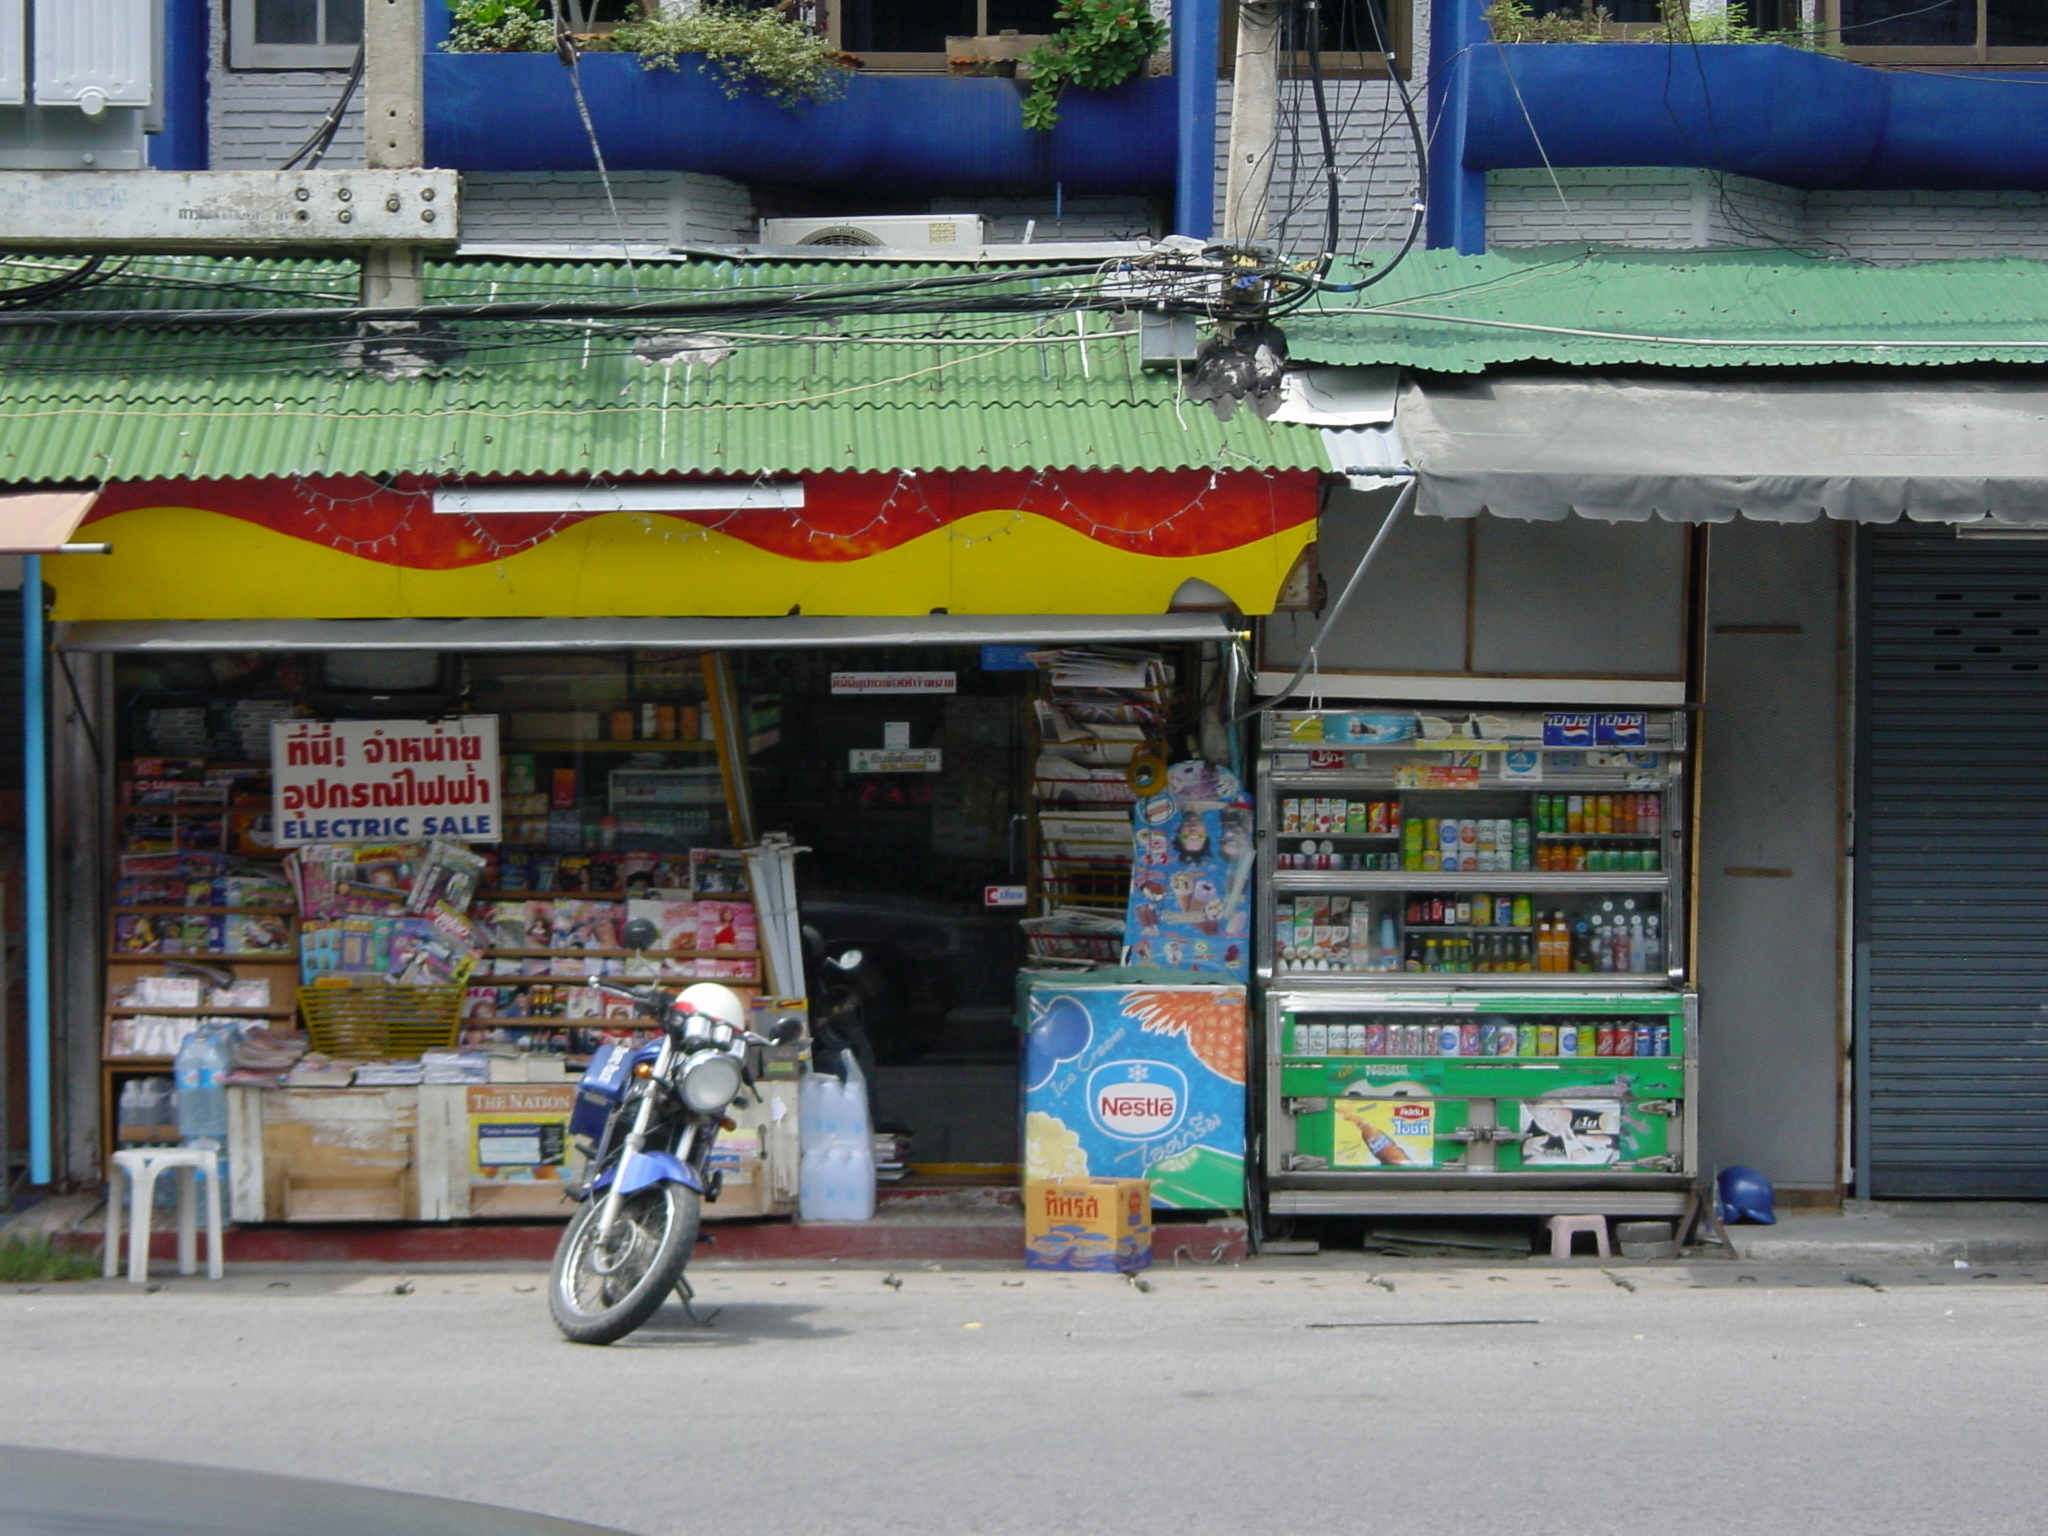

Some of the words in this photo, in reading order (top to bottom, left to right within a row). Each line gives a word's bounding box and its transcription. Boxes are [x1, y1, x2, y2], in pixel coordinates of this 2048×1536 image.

[287, 724, 346, 767] ที่นี่!
[362, 728, 481, 764] จำหน่าย
[283, 763, 490, 818] อุปกรณ์ไฟฟ้า
[283, 817, 409, 839] ELECTRIC
[423, 815, 491, 836] SALE
[1048, 1073, 1078, 1099] Ice
[1077, 1027, 1126, 1072] Cream
[507, 1094, 570, 1109] NATION
